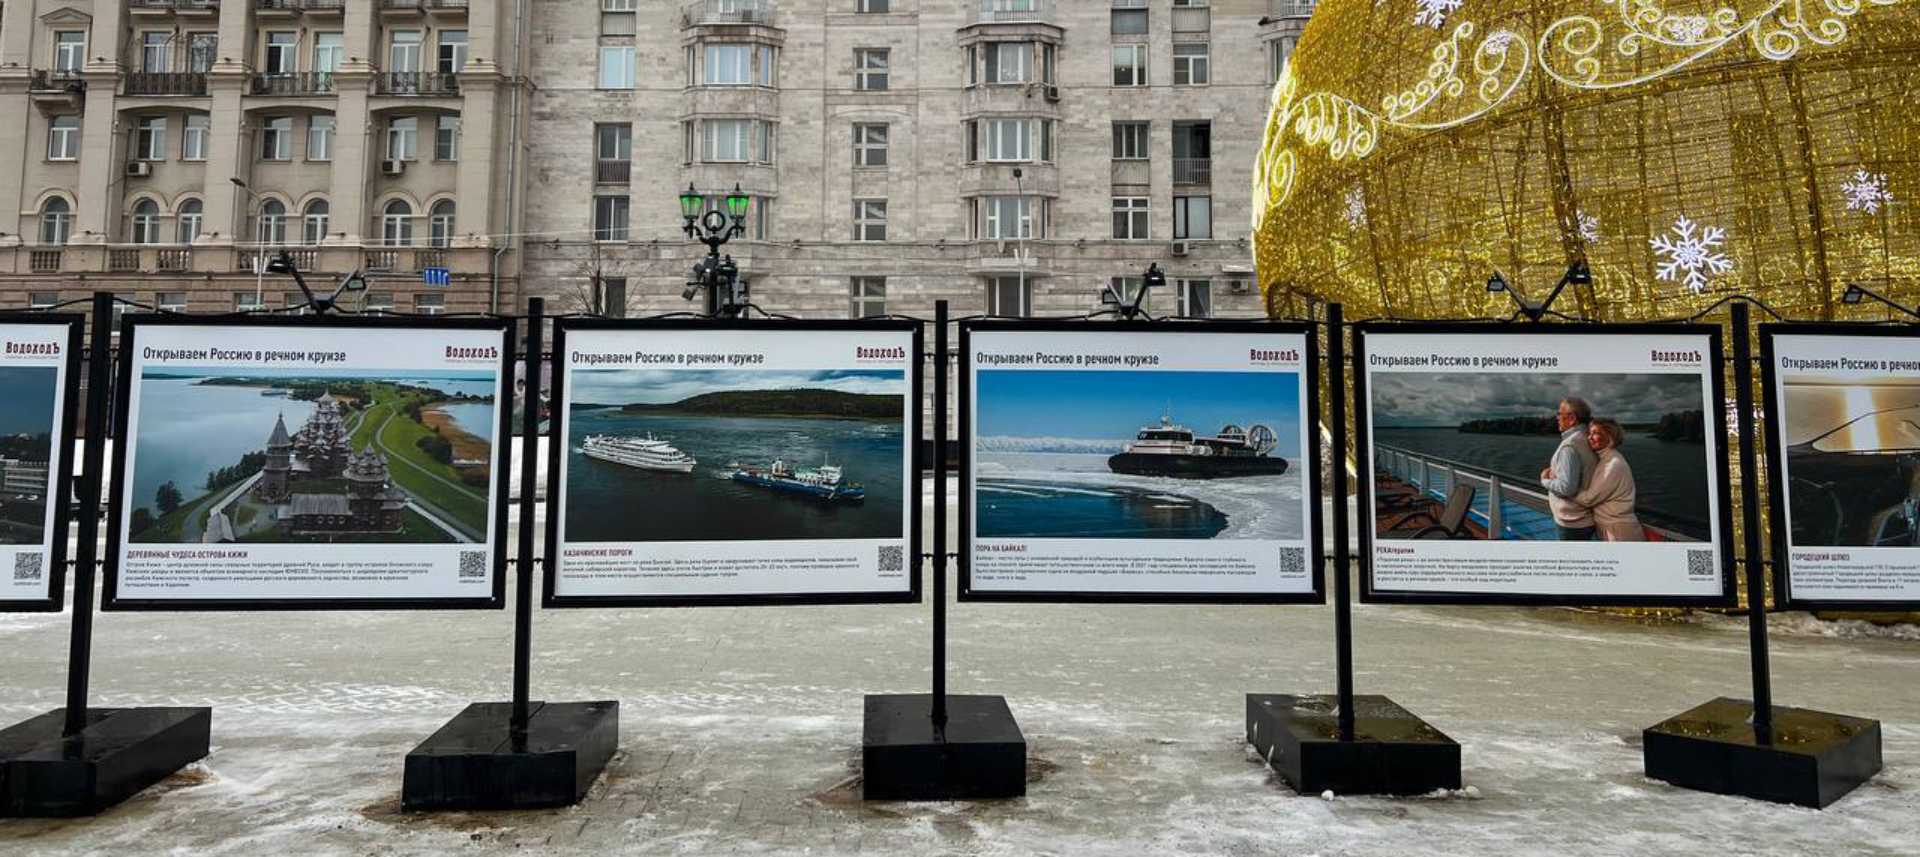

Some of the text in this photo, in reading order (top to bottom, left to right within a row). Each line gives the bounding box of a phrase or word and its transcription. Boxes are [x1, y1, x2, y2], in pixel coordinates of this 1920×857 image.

[5, 341, 60, 354] ВодоходЪ
[445, 345, 498, 358] ВодоходЪ
[856, 346, 906, 359] ВодоходЪ
[143, 346, 346, 364] Открываем Россию в речном круизе
[571, 350, 764, 367] Открываем Россию в речном круизе
[976, 351, 1159, 367] Открываем Россию в речном круизе
[1249, 348, 1300, 361] ВодоходЪ
[1370, 353, 1558, 369] Открываем Россию в речном круизе
[1651, 349, 1702, 362] ВодоходЪ
[1782, 356, 1920, 373] Открываем Россию в речно
[126, 550, 248, 560] ДЕРЕВЯННЫЕ ЧУДЕСА ОСТРОВА КИЖИ
[608, 548, 633, 557] ПОРОГИ
